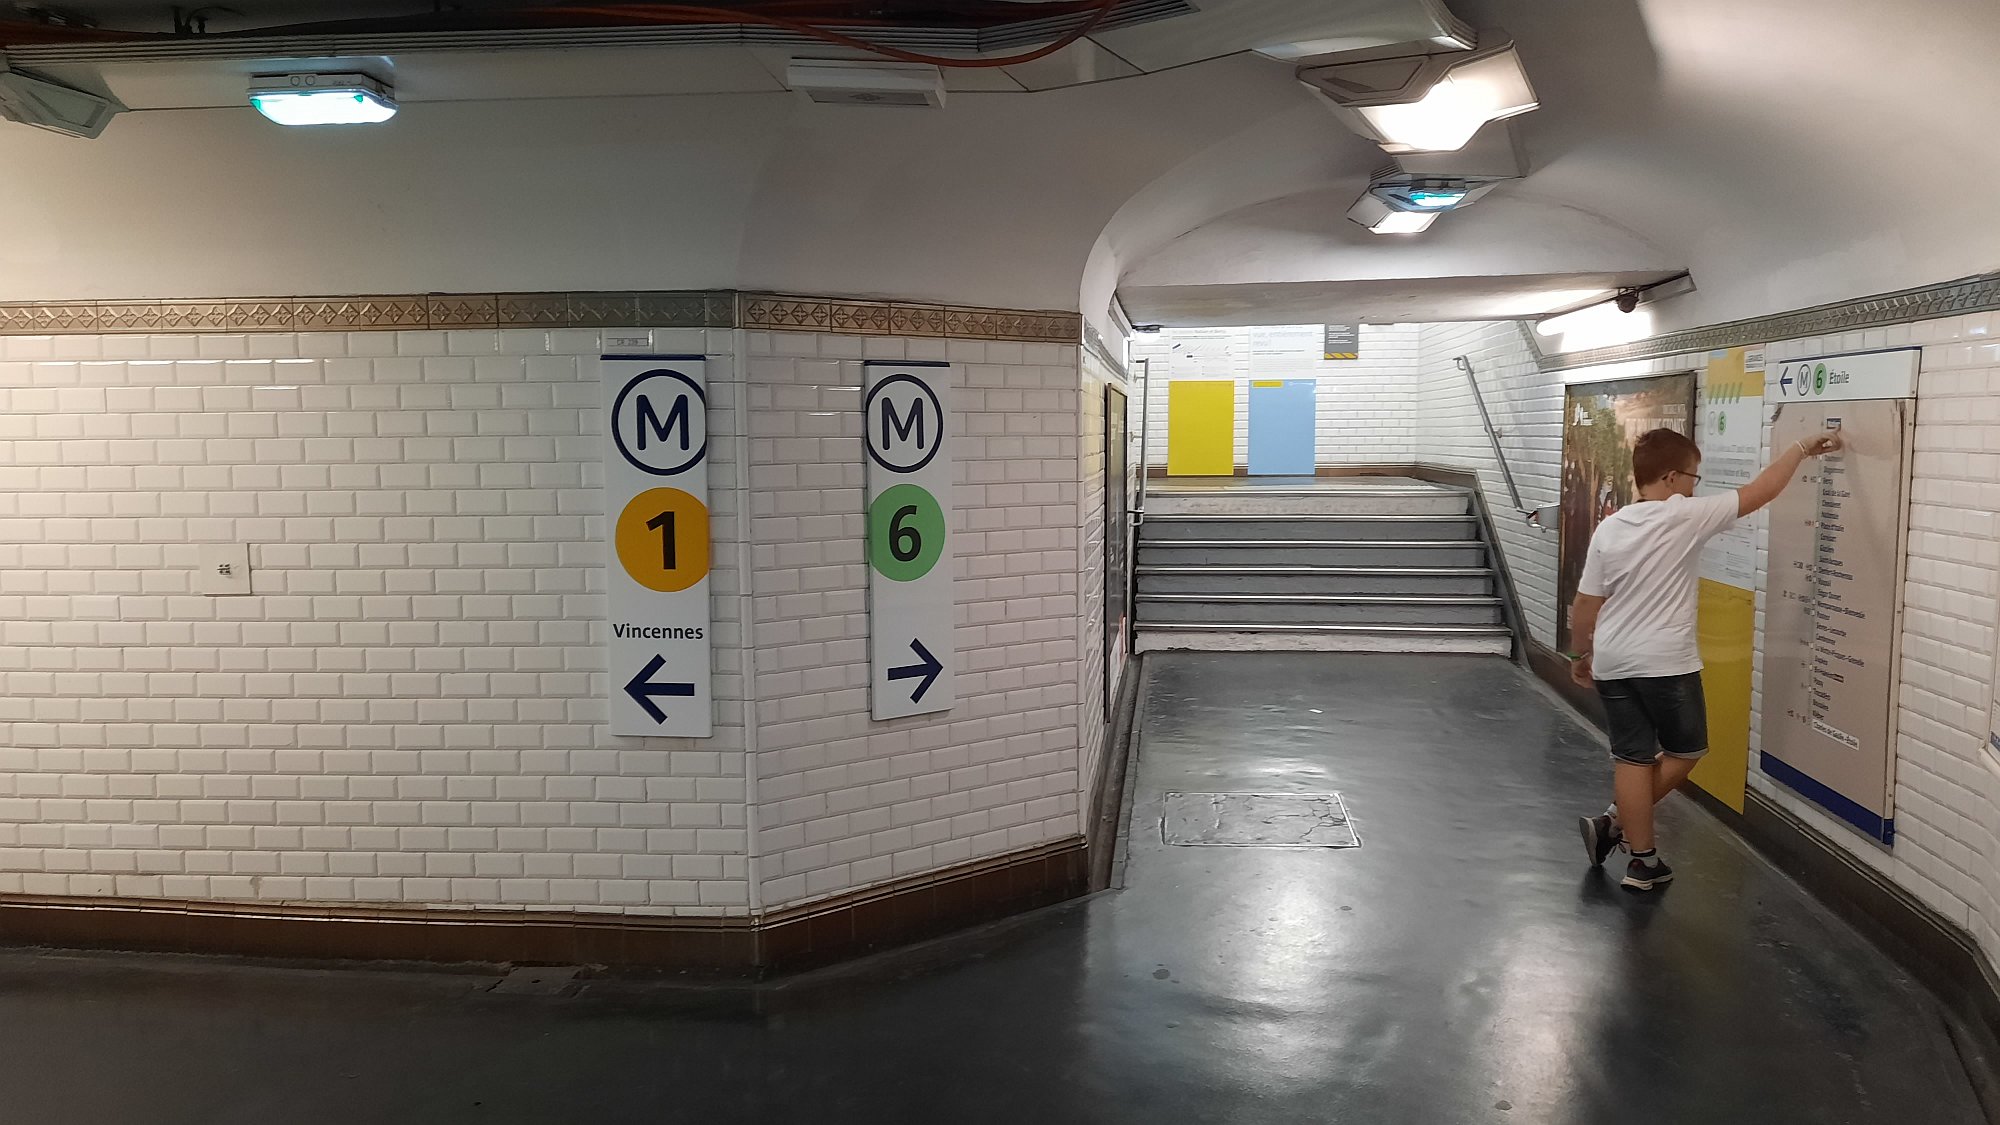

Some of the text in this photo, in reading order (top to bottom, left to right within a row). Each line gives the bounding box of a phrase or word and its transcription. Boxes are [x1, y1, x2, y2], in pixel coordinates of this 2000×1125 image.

[1816, 370, 1823, 388] 6
[1829, 369, 1850, 385] Étoile
[636, 394, 689, 451] M
[881, 397, 924, 451] M
[645, 511, 677, 570] 1
[889, 505, 922, 562] 6
[613, 622, 704, 640] Vincennes
